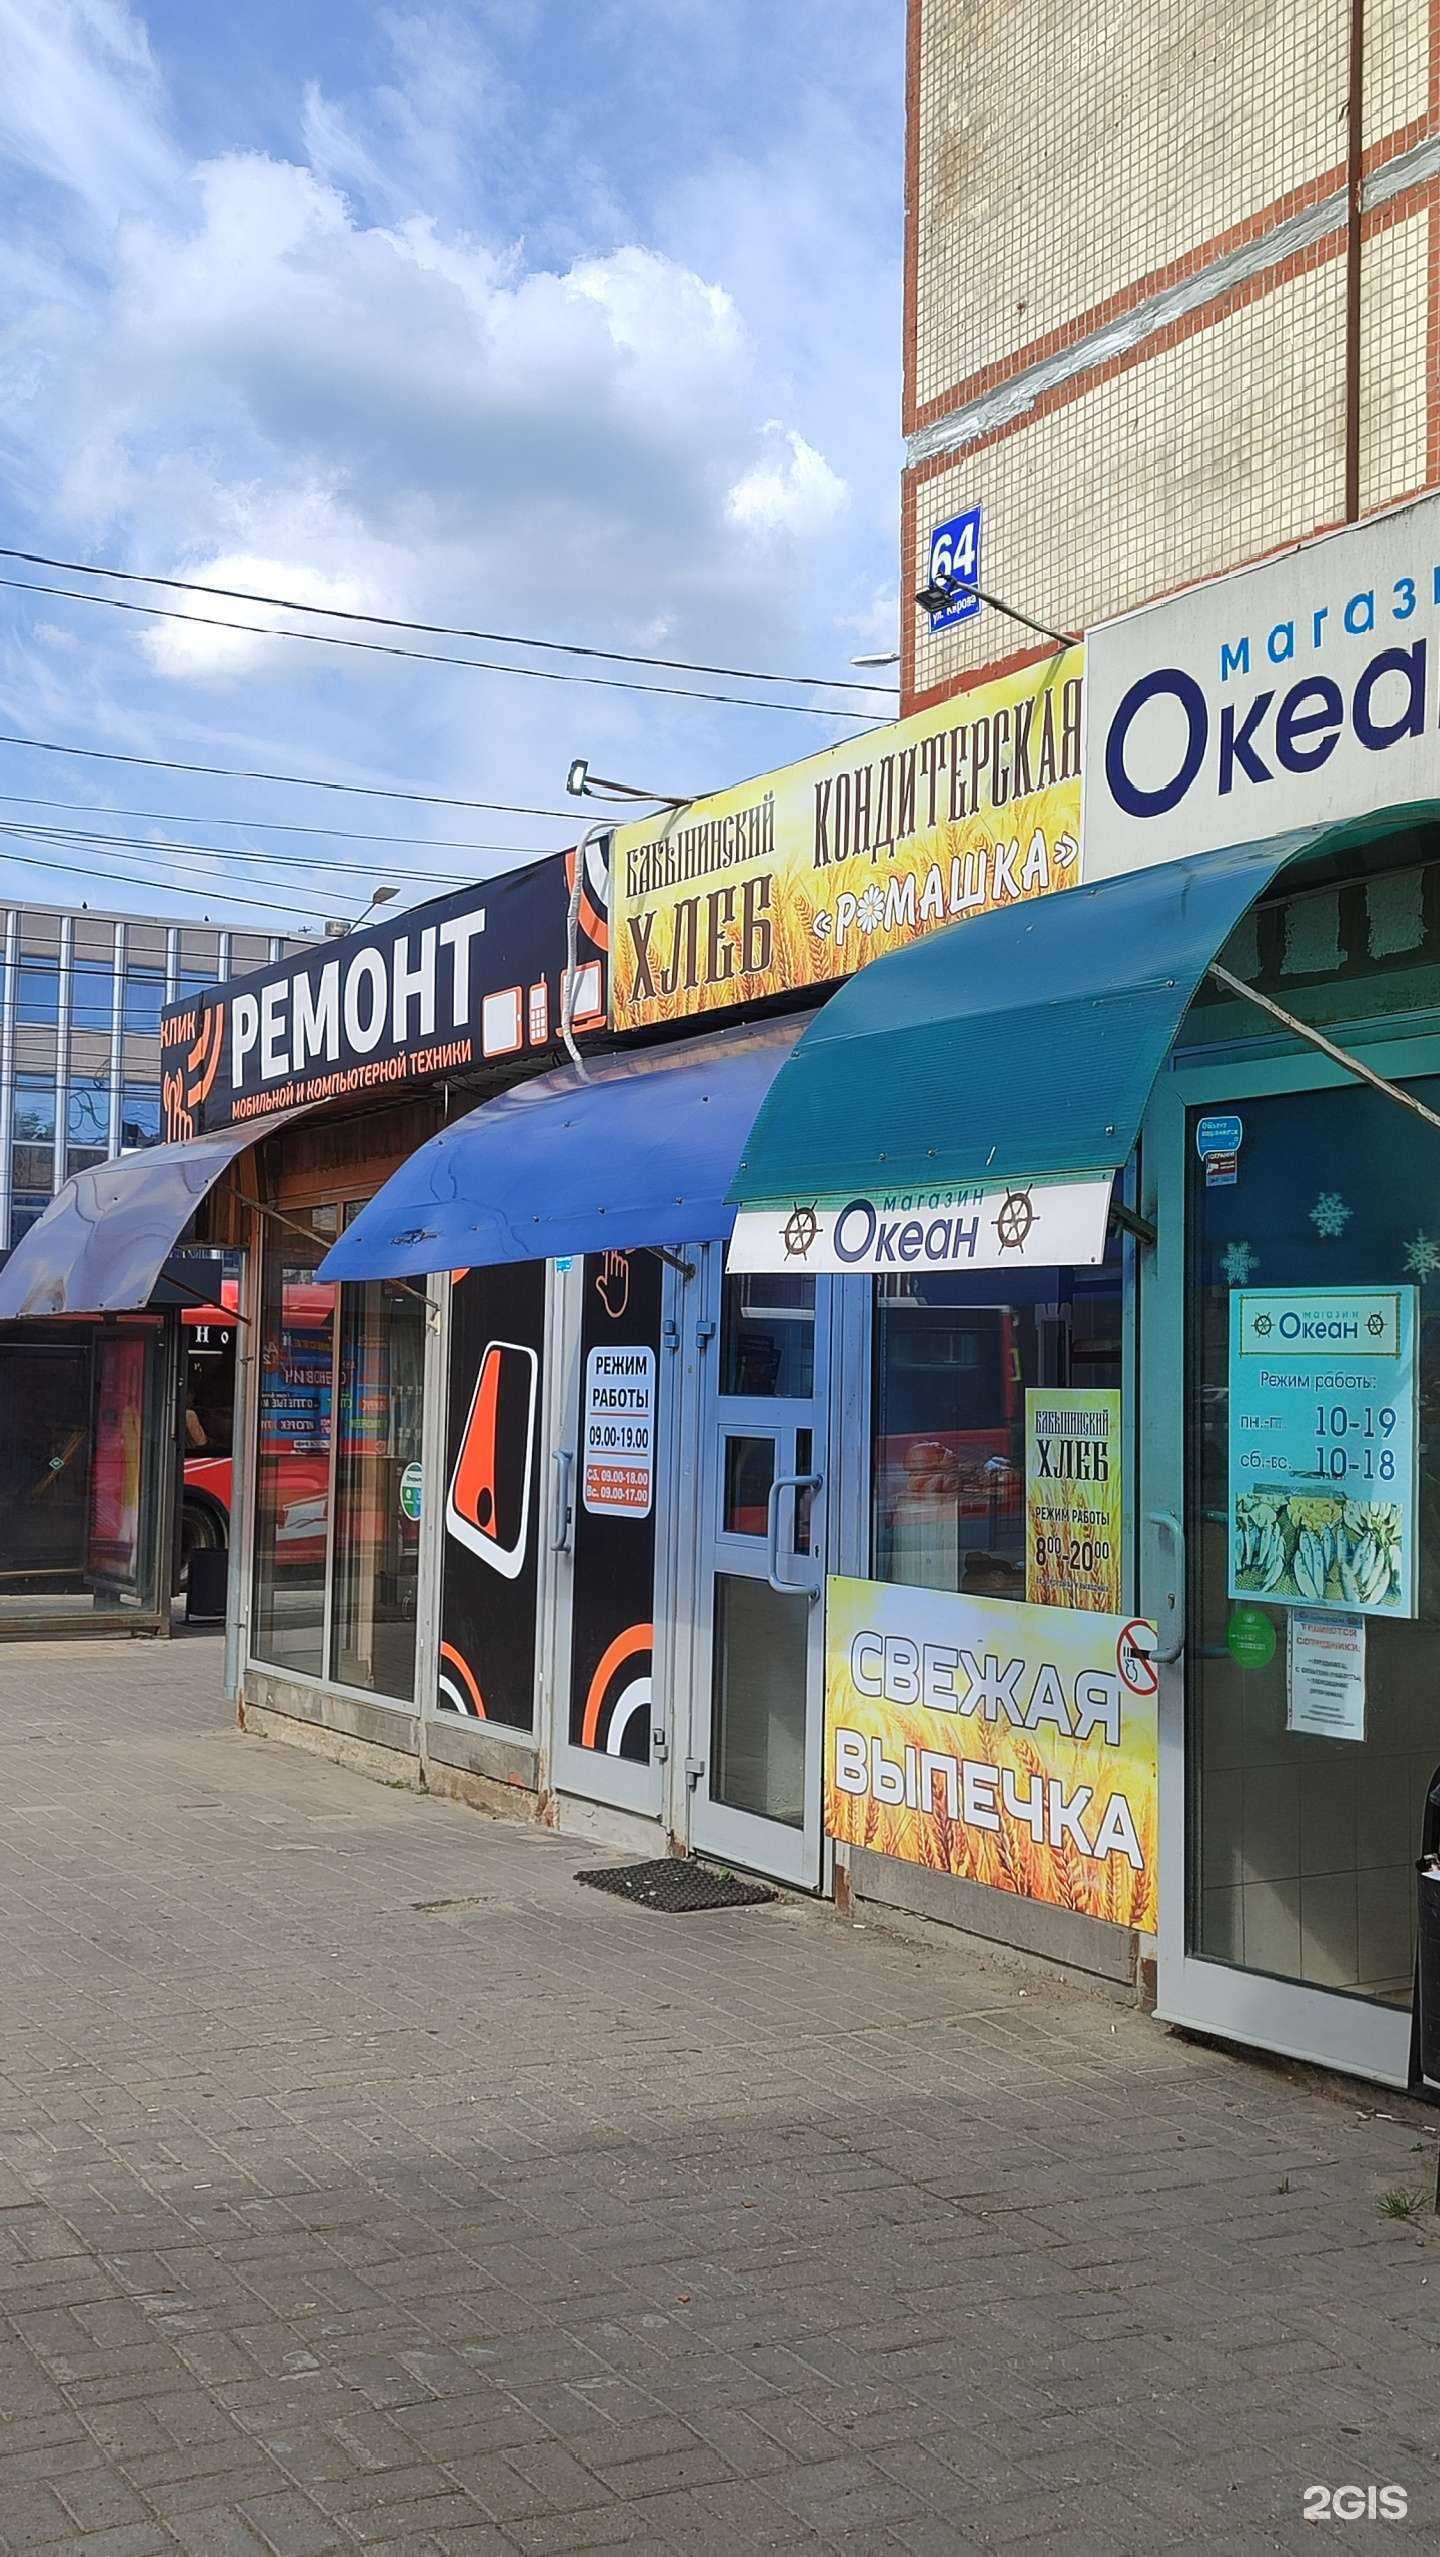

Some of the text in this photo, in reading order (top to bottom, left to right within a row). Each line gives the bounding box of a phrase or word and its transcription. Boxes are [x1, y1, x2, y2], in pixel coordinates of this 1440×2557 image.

[932, 522, 976, 580] 64
[1220, 566, 1440, 682] магаз
[1106, 637, 1440, 818] Океа
[813, 678, 1084, 869] КОНДИТЕРСКАЯ
[626, 790, 776, 898] БАБЫНИНСКИЙ
[627, 874, 775, 1003] ХЛЕБ
[231, 908, 486, 1089] РЕМОНТ
[160, 1011, 196, 1048] КЛИК
[231, 1038, 473, 1120] МОБИЛЬНОЙ И КОМПЬЮТЕРНОЙ ТЕХНИКИ
[883, 1187, 985, 1213] магазин
[833, 1198, 979, 1263] Океан
[1279, 1311, 1358, 1339] Океан
[596, 1356, 647, 1375] РЕЖИМ
[1260, 1371, 1310, 1387] Режим
[592, 1388, 649, 1408] РАБОТЫ
[1315, 1406, 1397, 1438] 10-19
[589, 1426, 649, 1449] 09.00-19.00
[1036, 1439, 1109, 1482] ХЛЕБ
[1315, 1447, 1396, 1481] 10-18
[1035, 1506, 1110, 1527] РЕЖИМ РАБОТЫ
[850, 1630, 1121, 1747] СВЕЖАЯ
[834, 1727, 1146, 1870] ВЫПЕЧКА
